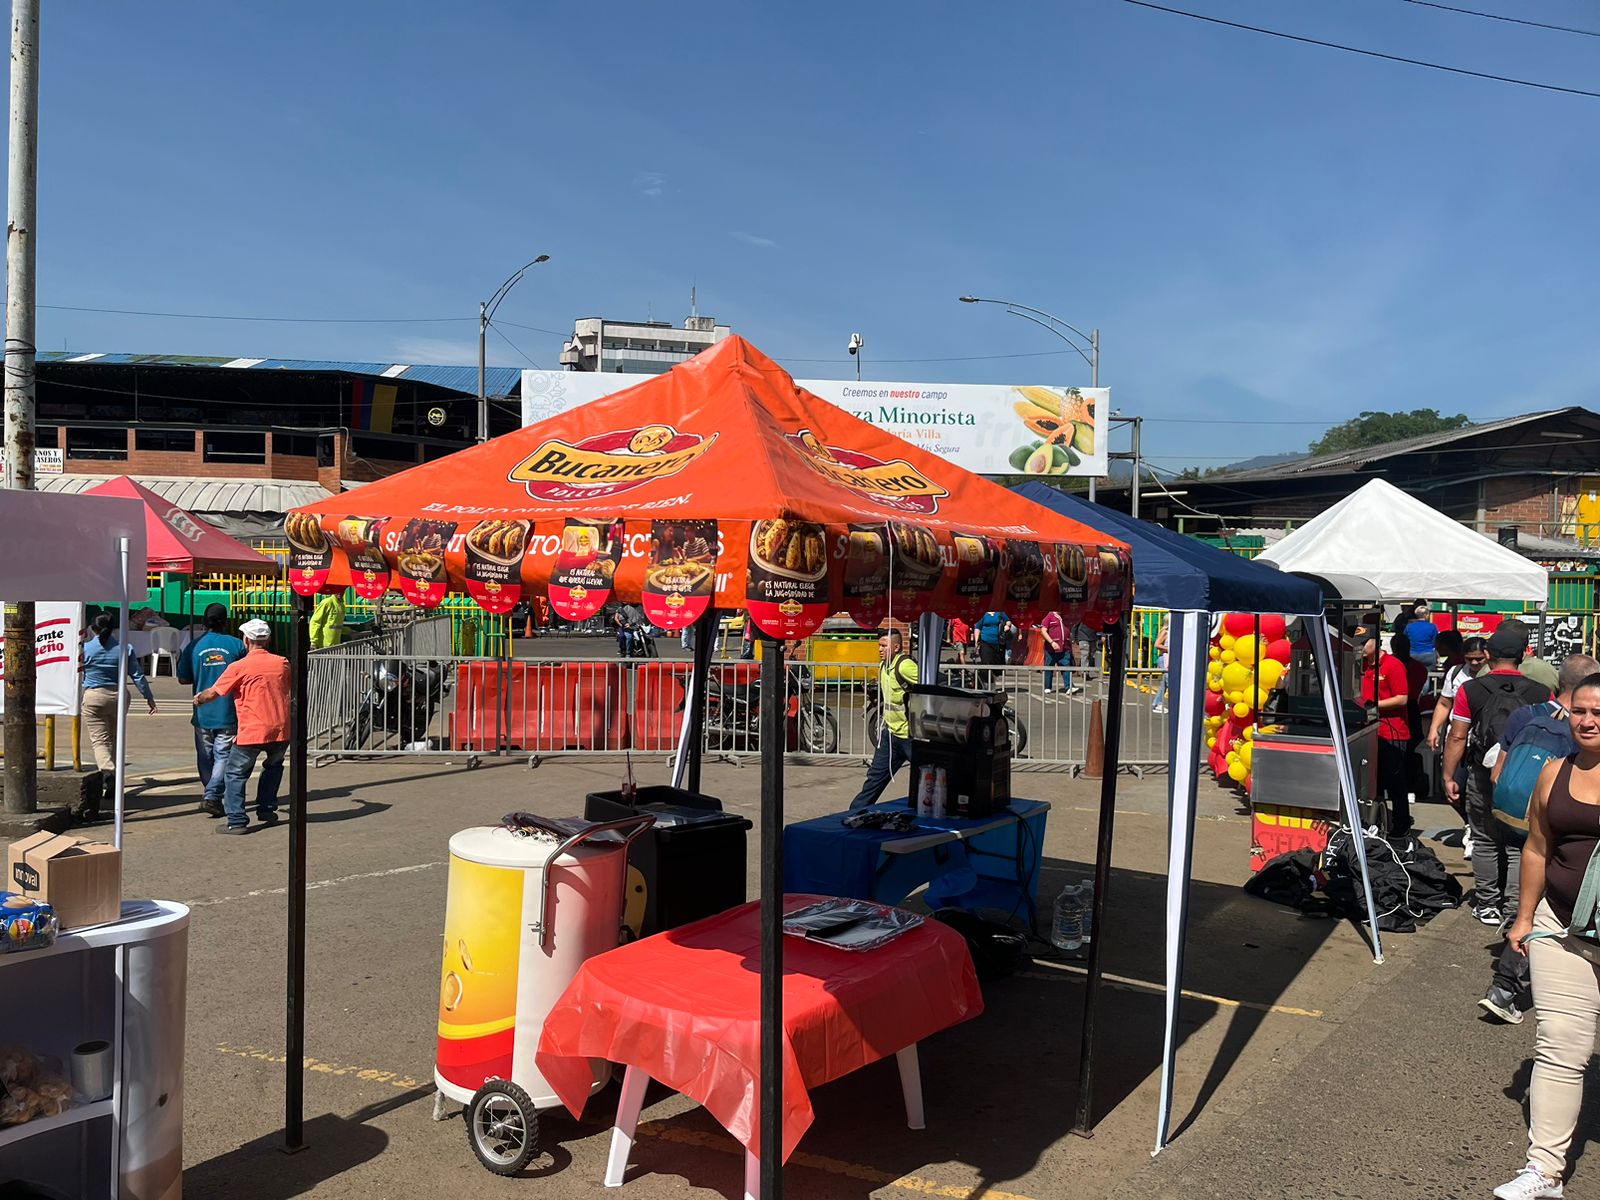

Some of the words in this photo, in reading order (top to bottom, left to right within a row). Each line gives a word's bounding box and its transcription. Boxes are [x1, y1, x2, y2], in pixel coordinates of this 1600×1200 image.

[843, 387, 877, 398] Creemos
[879, 389, 889, 398] en
[890, 389, 920, 398] nuestro
[921, 390, 947, 401] campo
[878, 406, 976, 426] Minorista
[916, 429, 941, 440] Villa
[933, 444, 960, 455] Segura
[528, 449, 695, 479] Bucanero
[545, 486, 615, 498] POLLOS
[765, 581, 772, 589] ES
[773, 581, 798, 590] NATURAL
[765, 589, 773, 597] LA
